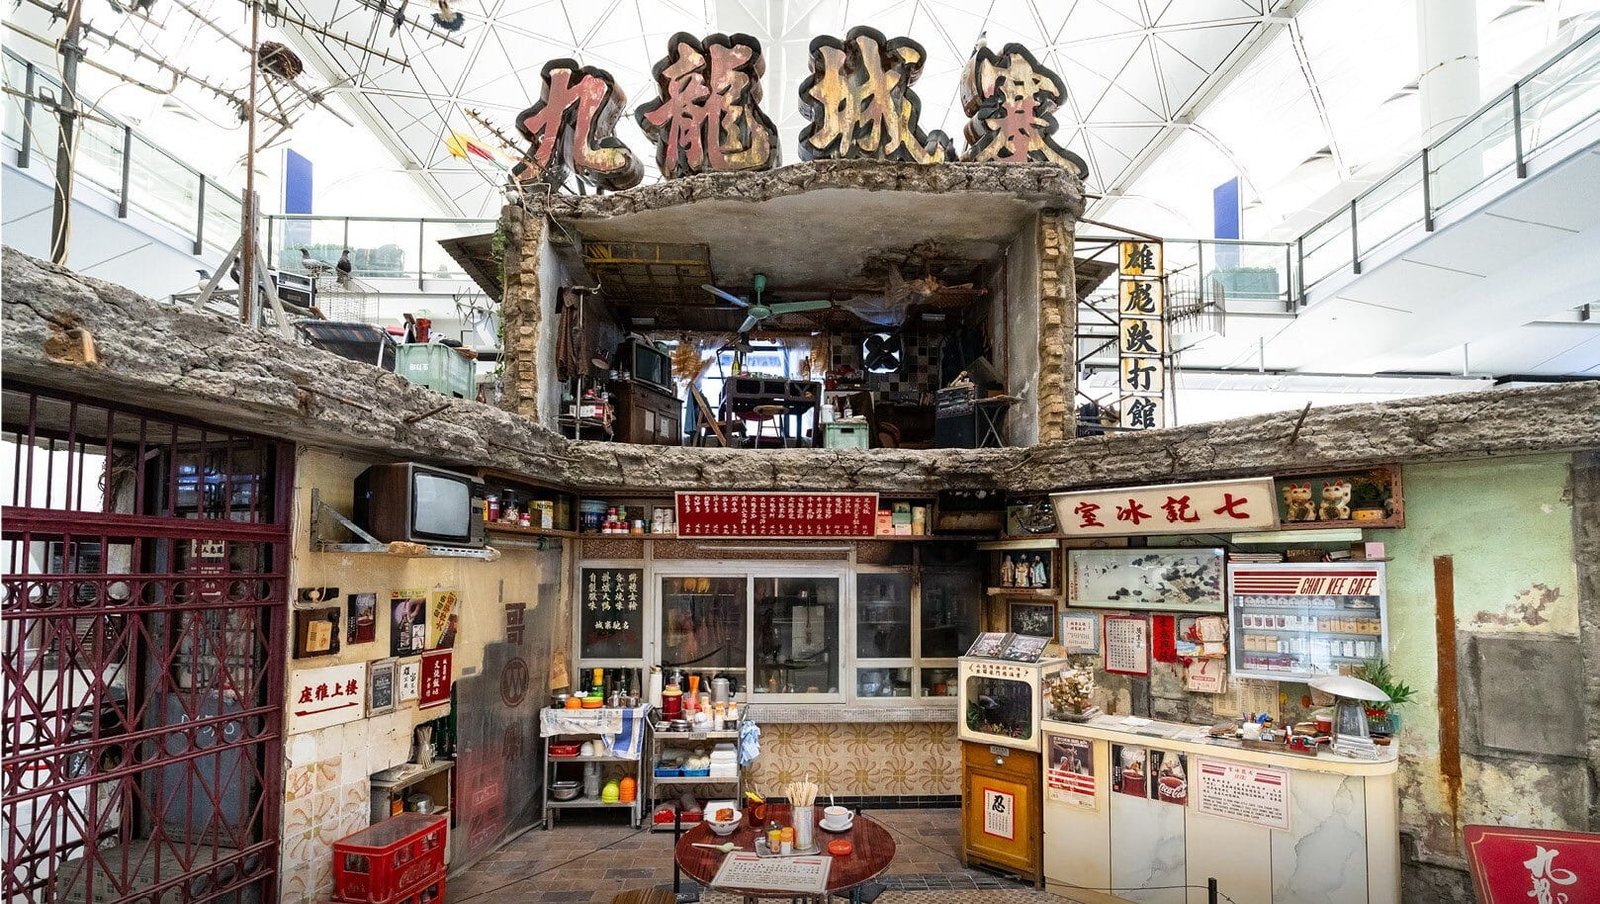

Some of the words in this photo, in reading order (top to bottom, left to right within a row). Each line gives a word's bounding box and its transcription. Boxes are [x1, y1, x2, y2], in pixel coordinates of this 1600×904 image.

[513, 28, 1086, 186] 九龍城寨
[1125, 243, 1157, 429] 雄彪跌打館
[1074, 493, 1250, 528] 七記冰室
[1300, 577, 1326, 594] CHAT
[1326, 577, 1348, 595] KEE
[1348, 578, 1376, 595] CAFE
[1198, 657, 1210, 675] 7
[298, 678, 359, 704] 樓上雅座
